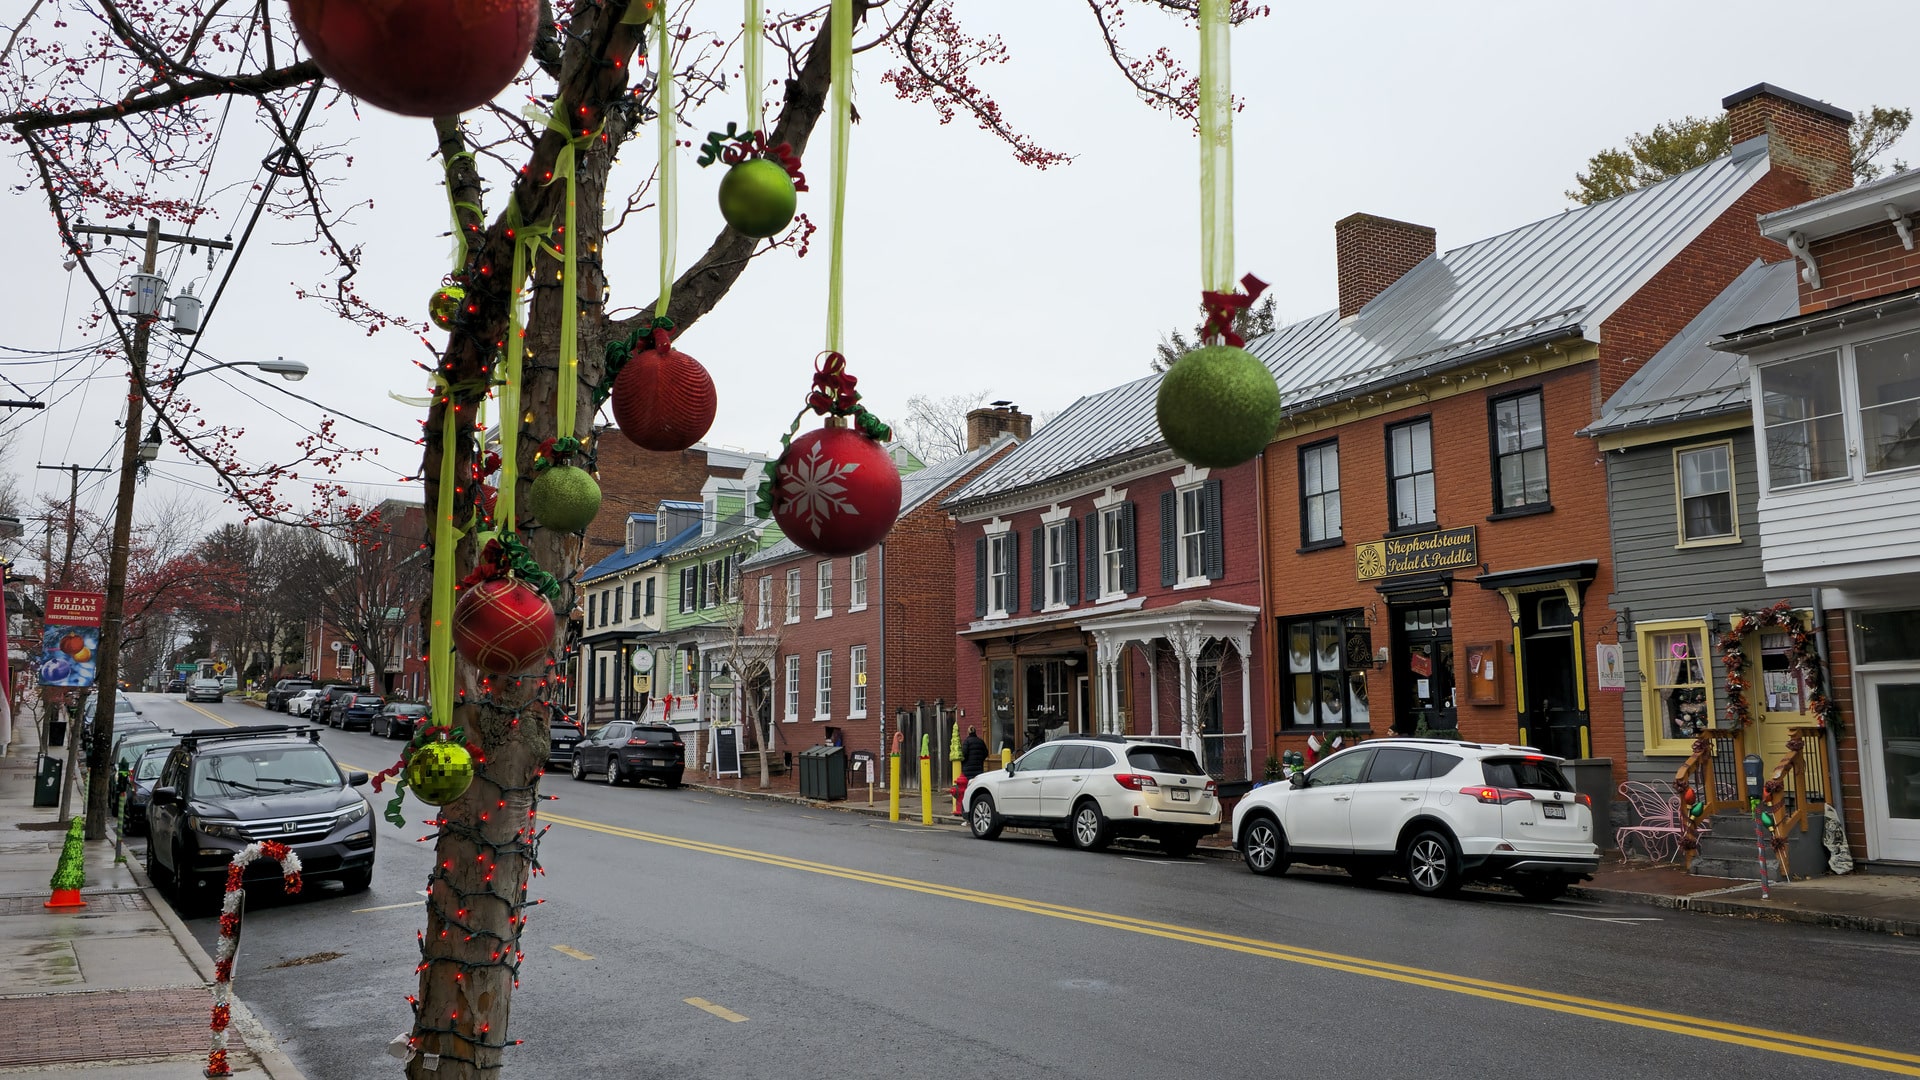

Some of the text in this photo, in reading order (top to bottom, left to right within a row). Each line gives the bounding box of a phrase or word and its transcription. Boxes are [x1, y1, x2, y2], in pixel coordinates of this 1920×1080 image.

[1387, 534, 1471, 556] Shepherdstown
[1388, 549, 1472, 573] Pedal & Paddle
[1431, 627, 1438, 637] 5
